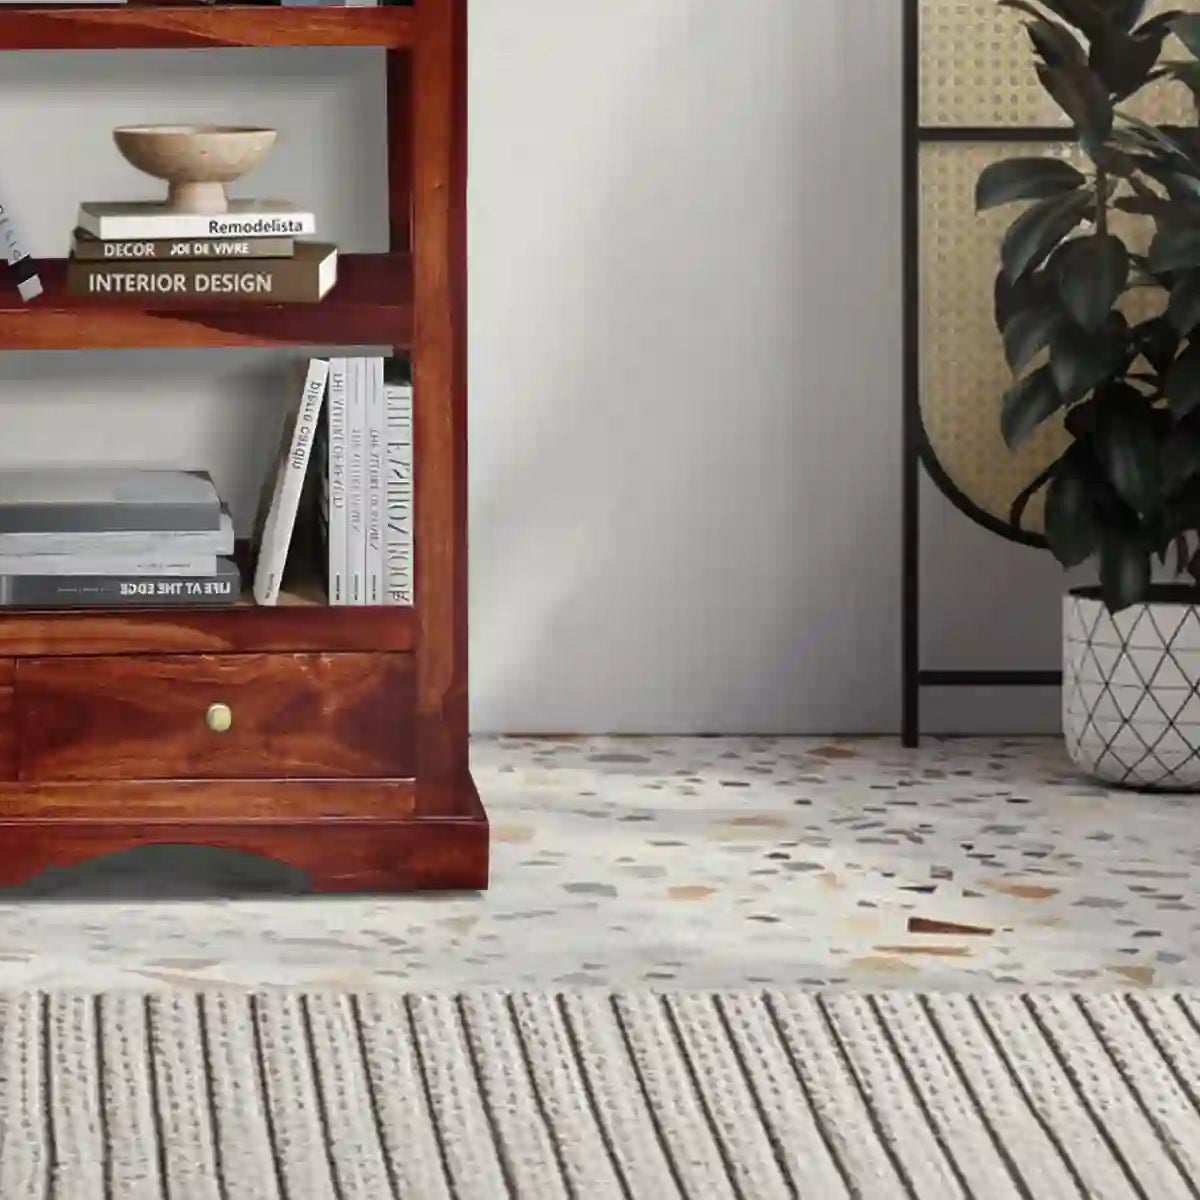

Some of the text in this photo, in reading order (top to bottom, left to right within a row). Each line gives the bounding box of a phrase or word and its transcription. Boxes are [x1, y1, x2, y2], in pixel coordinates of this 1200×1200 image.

[208, 218, 303, 234] Remodelista
[212, 242, 250, 256] VIVRE
[88, 273, 273, 293] INTERIOR DESIGN
